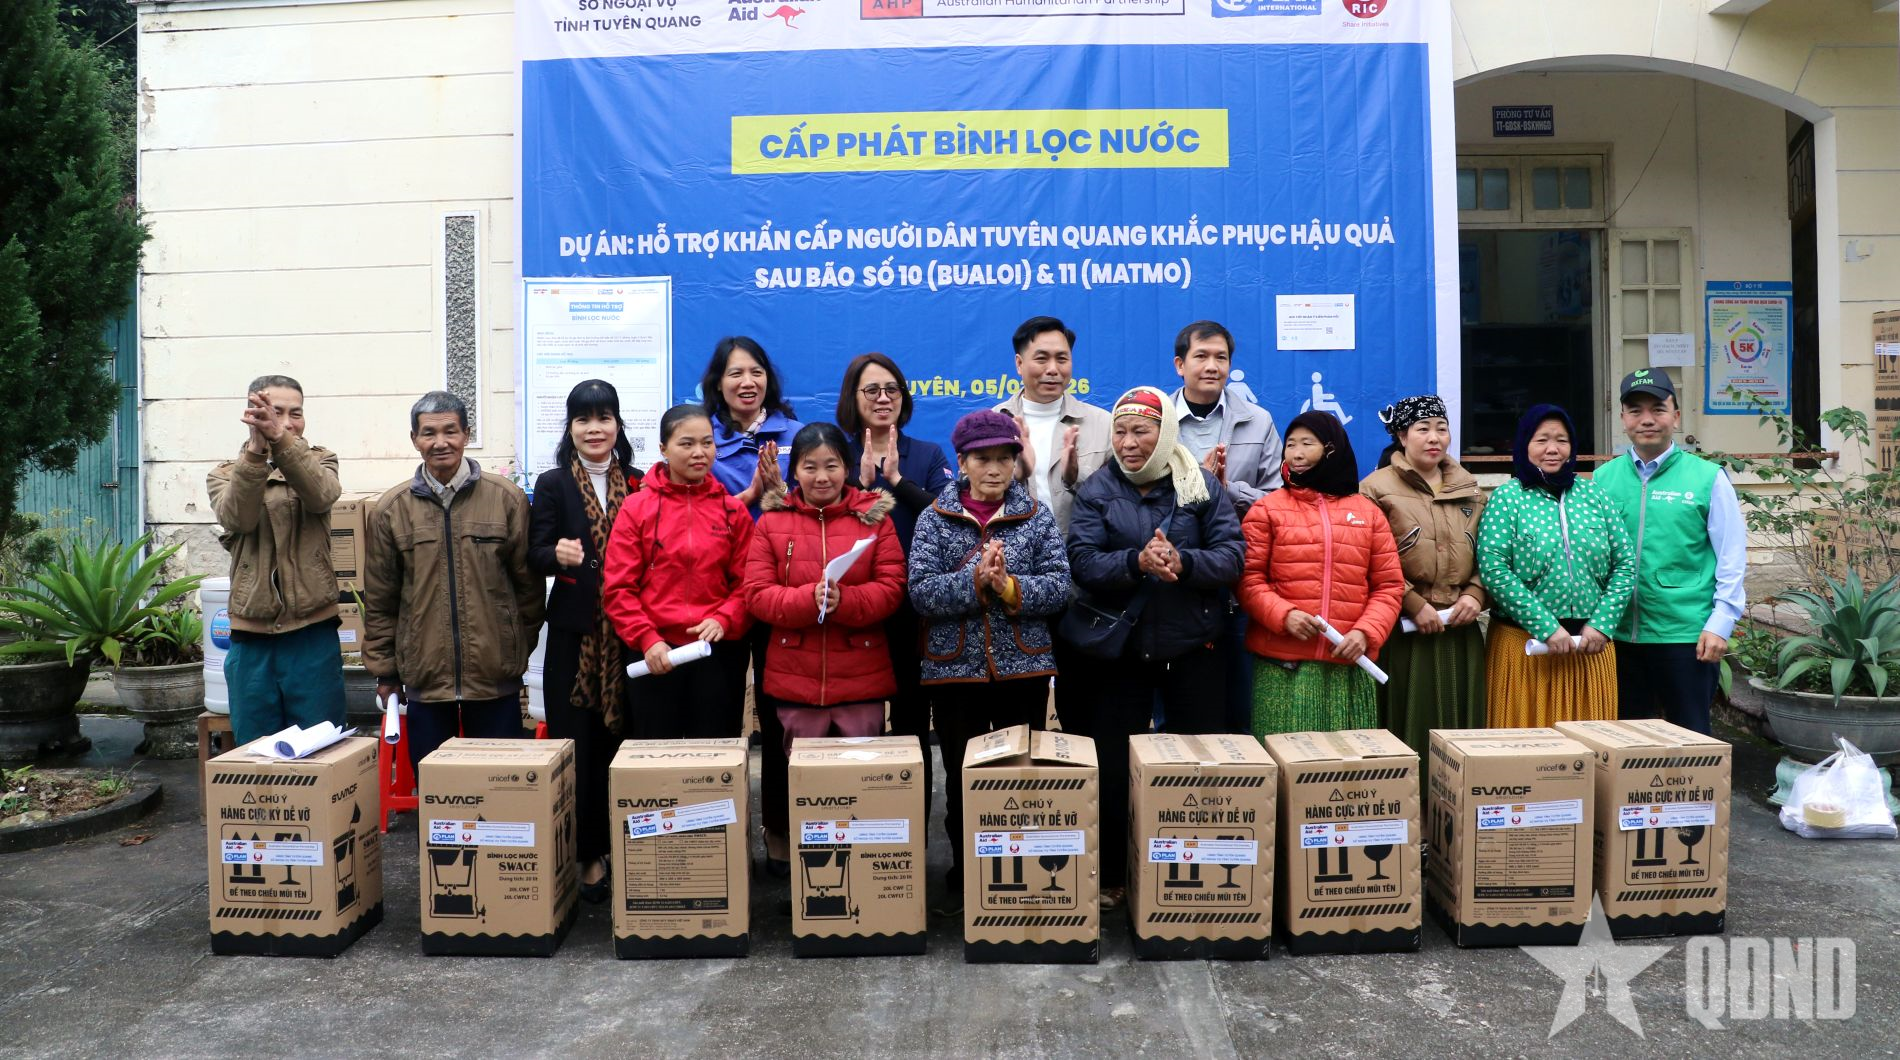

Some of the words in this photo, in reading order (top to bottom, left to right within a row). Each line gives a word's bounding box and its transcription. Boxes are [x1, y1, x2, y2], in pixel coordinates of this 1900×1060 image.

[728, 6, 758, 21] Aid
[1352, 3, 1379, 14] RIC
[554, 17, 589, 32] TỈNH
[593, 15, 642, 31] TUYÊN
[645, 15, 702, 30] QUANG
[759, 121, 830, 159] CẤP
[837, 123, 927, 157] PHÁT
[934, 122, 1018, 155] BÌNH
[1026, 128, 1092, 162] LỌC
[1100, 120, 1200, 153] NƯỚC
[559, 233, 593, 263] DỰ
[594, 229, 634, 257] ÁN:
[637, 222, 671, 255] HỖ
[674, 229, 719, 260] TRỢ
[723, 219, 791, 252] KHẨN
[794, 218, 843, 250] CẤP
[846, 221, 922, 249] NGƯỜI
[926, 221, 977, 248] DÂN
[981, 219, 1058, 247] TUYÊN
[1062, 225, 1147, 250] QUANG
[1151, 213, 1218, 247] KHẮC
[1222, 224, 1286, 251] PHỤC
[1290, 217, 1340, 251] HẬU
[1344, 215, 1395, 247] QUẢ
[755, 267, 801, 289] SAU
[806, 261, 855, 288] BÃO
[863, 255, 894, 287] SỐ
[898, 265, 922, 286] 10
[927, 257, 1032, 292] (BUALOI)
[1036, 263, 1055, 285] &
[1058, 263, 1077, 284] 11
[1081, 257, 1192, 290] (MATMO)
[1739, 343, 1754, 353] 5K
[1536, 763, 1558, 772] unicef
[488, 774, 511, 782] unicef
[682, 775, 706, 784] unicef
[861, 773, 884, 782] unicef
[1666, 776, 1686, 785] CHÚ
[1346, 788, 1368, 800] CHÚ
[1471, 785, 1532, 796] SWACF
[1628, 789, 1652, 804] HÀNG
[1675, 787, 1687, 802] KỲ
[1688, 785, 1700, 801] DỄ
[1702, 786, 1714, 801] VỠ
[258, 793, 279, 804] CHÚ
[424, 794, 485, 805] SWACF
[617, 798, 679, 808] SWACF
[796, 796, 858, 807] SWACF
[1022, 798, 1044, 809] CHÚ
[1201, 795, 1223, 806] CHÚ
[220, 804, 246, 820] HÀNG
[248, 806, 267, 823] CỰC
[269, 807, 280, 821] KỲ
[283, 804, 296, 821] DỄ
[298, 807, 311, 822] VỠ
[1305, 804, 1332, 819] HÀNG
[1335, 803, 1355, 820] CỰC
[1357, 801, 1370, 816] KỲ
[1373, 798, 1386, 815] DỄ
[1388, 800, 1401, 814] VỠ
[980, 811, 1007, 826] HÀNG
[1032, 811, 1046, 826] KỲ
[1048, 809, 1061, 826] DỄ
[1064, 812, 1078, 826] VỠ
[1158, 808, 1186, 823] HÀNG
[1189, 808, 1209, 826] CỰC
[1211, 808, 1226, 823] KỲ
[1227, 806, 1239, 823] DỄ
[1242, 808, 1256, 823] VỠ
